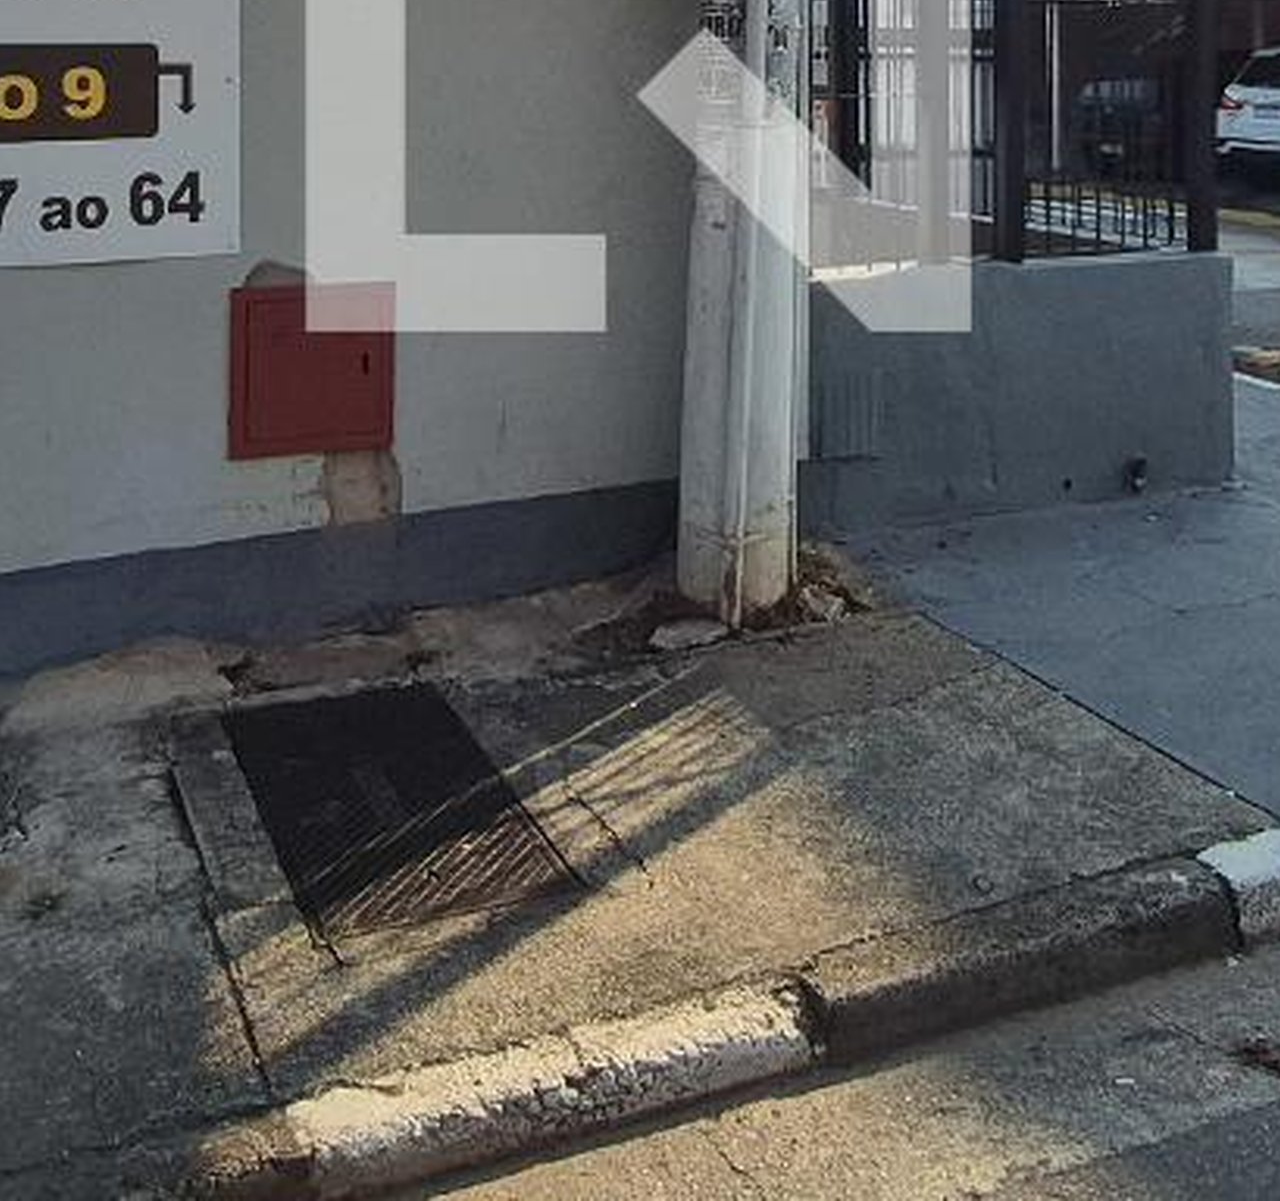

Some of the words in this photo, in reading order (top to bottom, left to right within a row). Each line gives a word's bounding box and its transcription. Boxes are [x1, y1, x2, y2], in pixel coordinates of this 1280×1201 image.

[61, 66, 107, 121] 9
[39, 191, 110, 233] ao
[127, 170, 205, 225] 64
